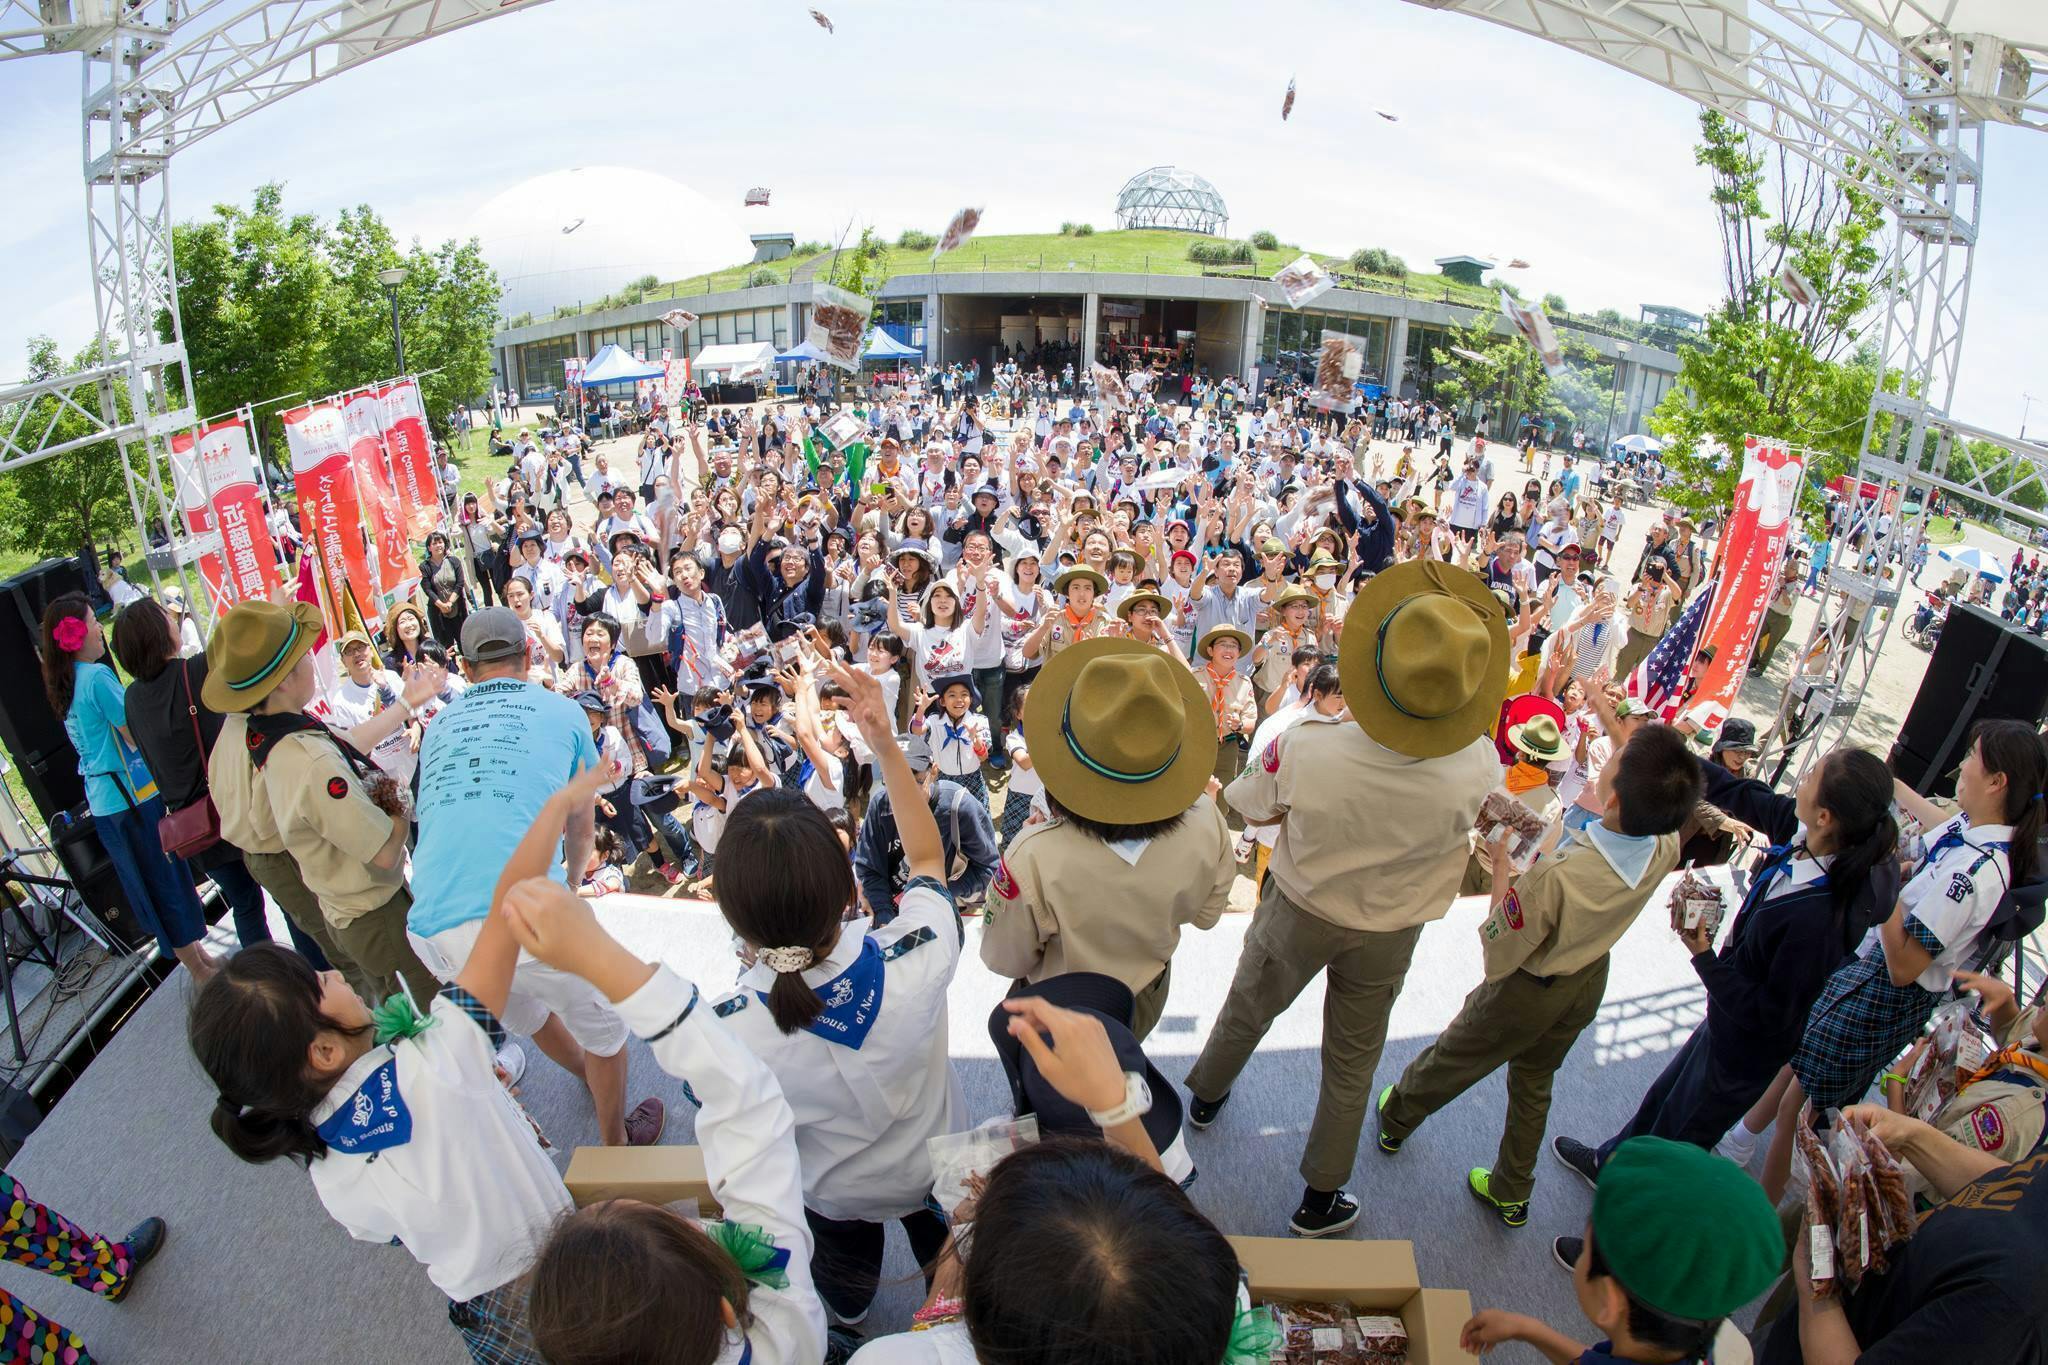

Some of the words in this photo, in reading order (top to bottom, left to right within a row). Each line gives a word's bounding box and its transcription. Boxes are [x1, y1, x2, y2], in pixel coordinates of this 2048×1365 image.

[464, 681, 527, 698] Volunteer
[1948, 881, 1966, 901] 55
[1486, 920, 1499, 939] 35
[856, 1010, 866, 1024] of
[382, 1105, 398, 1118] of
